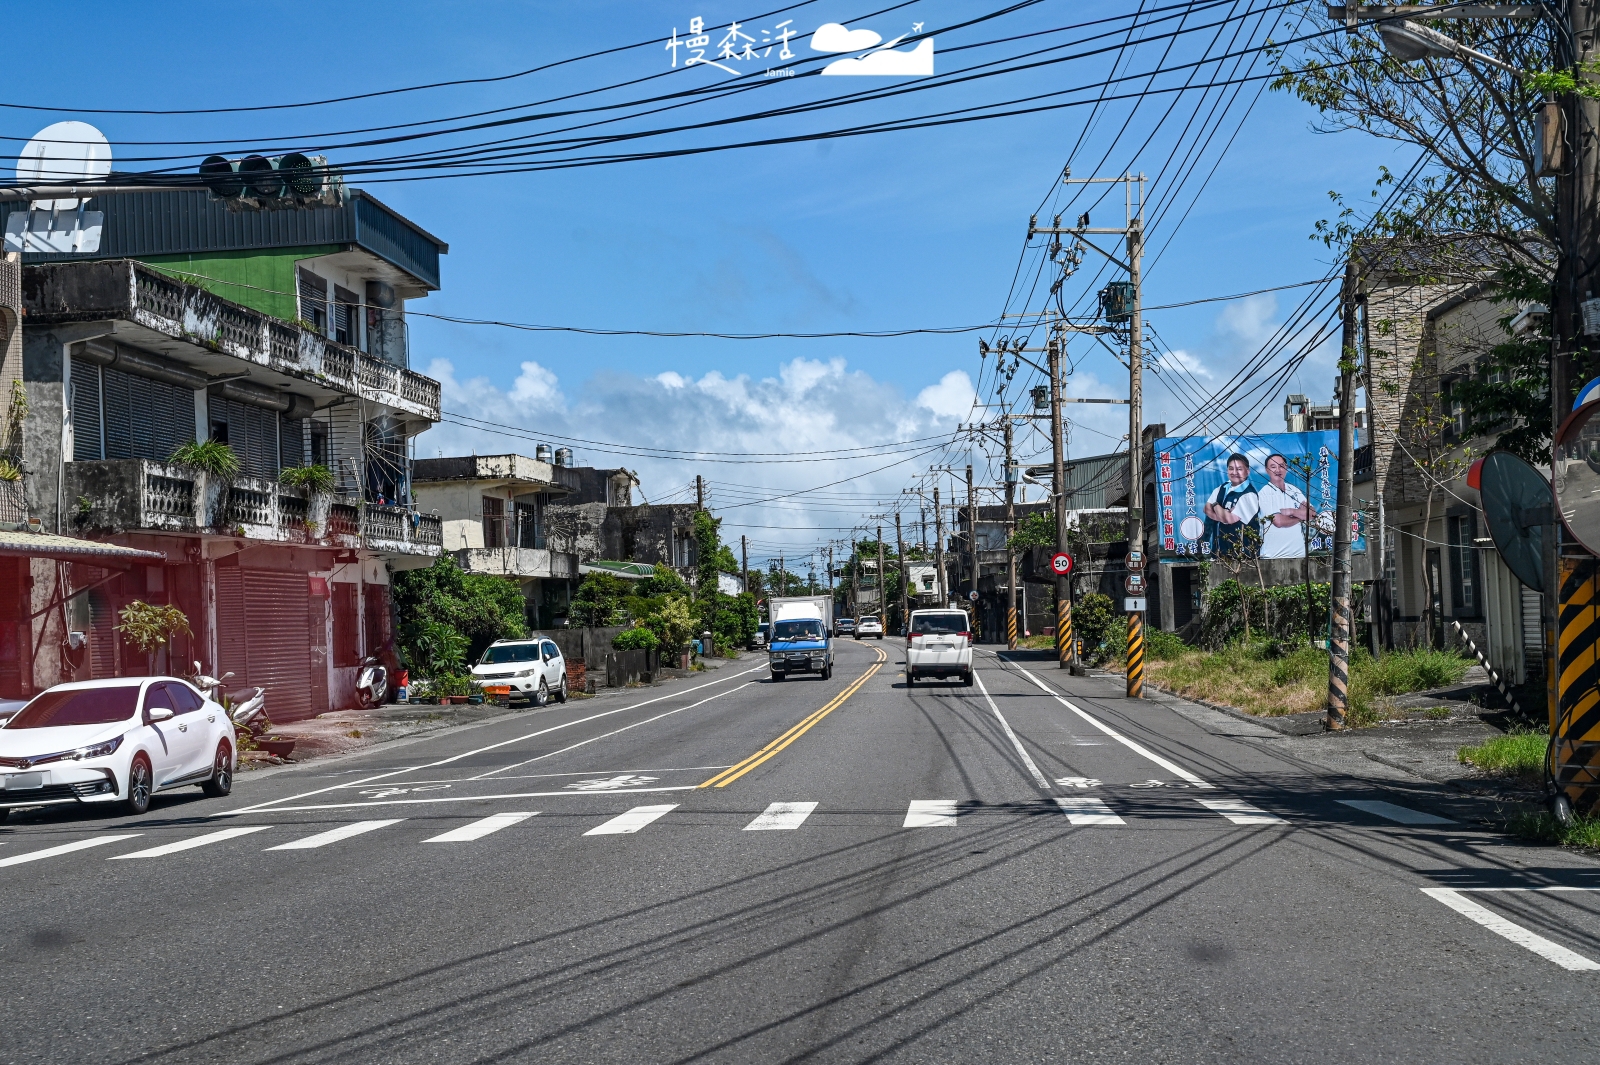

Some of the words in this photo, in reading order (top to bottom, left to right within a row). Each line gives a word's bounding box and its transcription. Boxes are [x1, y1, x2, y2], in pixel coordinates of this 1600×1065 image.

[1160, 453, 1174, 551] 團結宜蘭走新路
[1185, 453, 1196, 515] 宜蘭縣長參選人
[1055, 560, 1068, 568] 50
